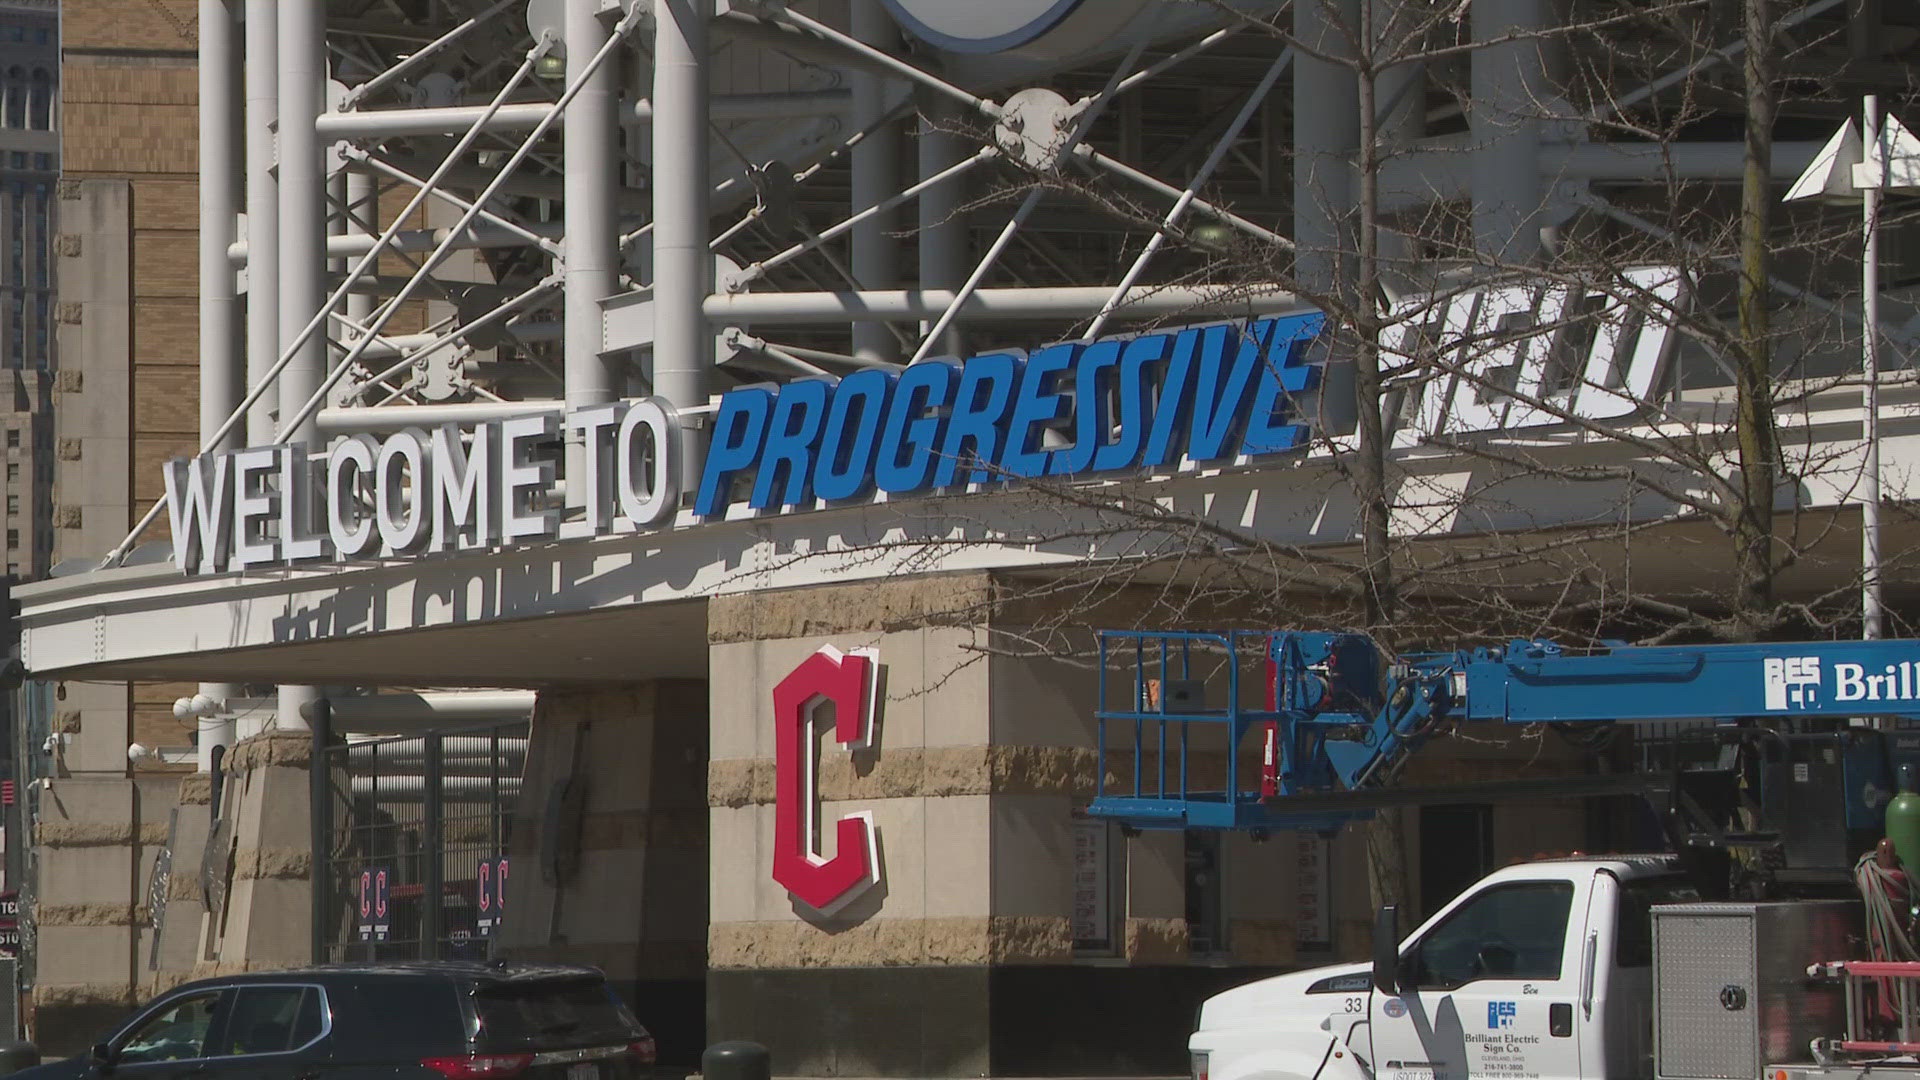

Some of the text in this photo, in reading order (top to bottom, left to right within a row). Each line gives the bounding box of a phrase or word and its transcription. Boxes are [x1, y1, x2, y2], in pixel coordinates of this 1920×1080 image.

[162, 414, 553, 574] WELCOME
[571, 397, 678, 537] TO
[693, 310, 1327, 517] PROGRESSIVE
[772, 644, 880, 910] C
[1523, 984, 1539, 995] Ben
[1345, 998, 1362, 1013] 33
[1465, 1033, 1540, 1044] Brilliant Electric
[1483, 1044, 1522, 1054] Sign Co.
